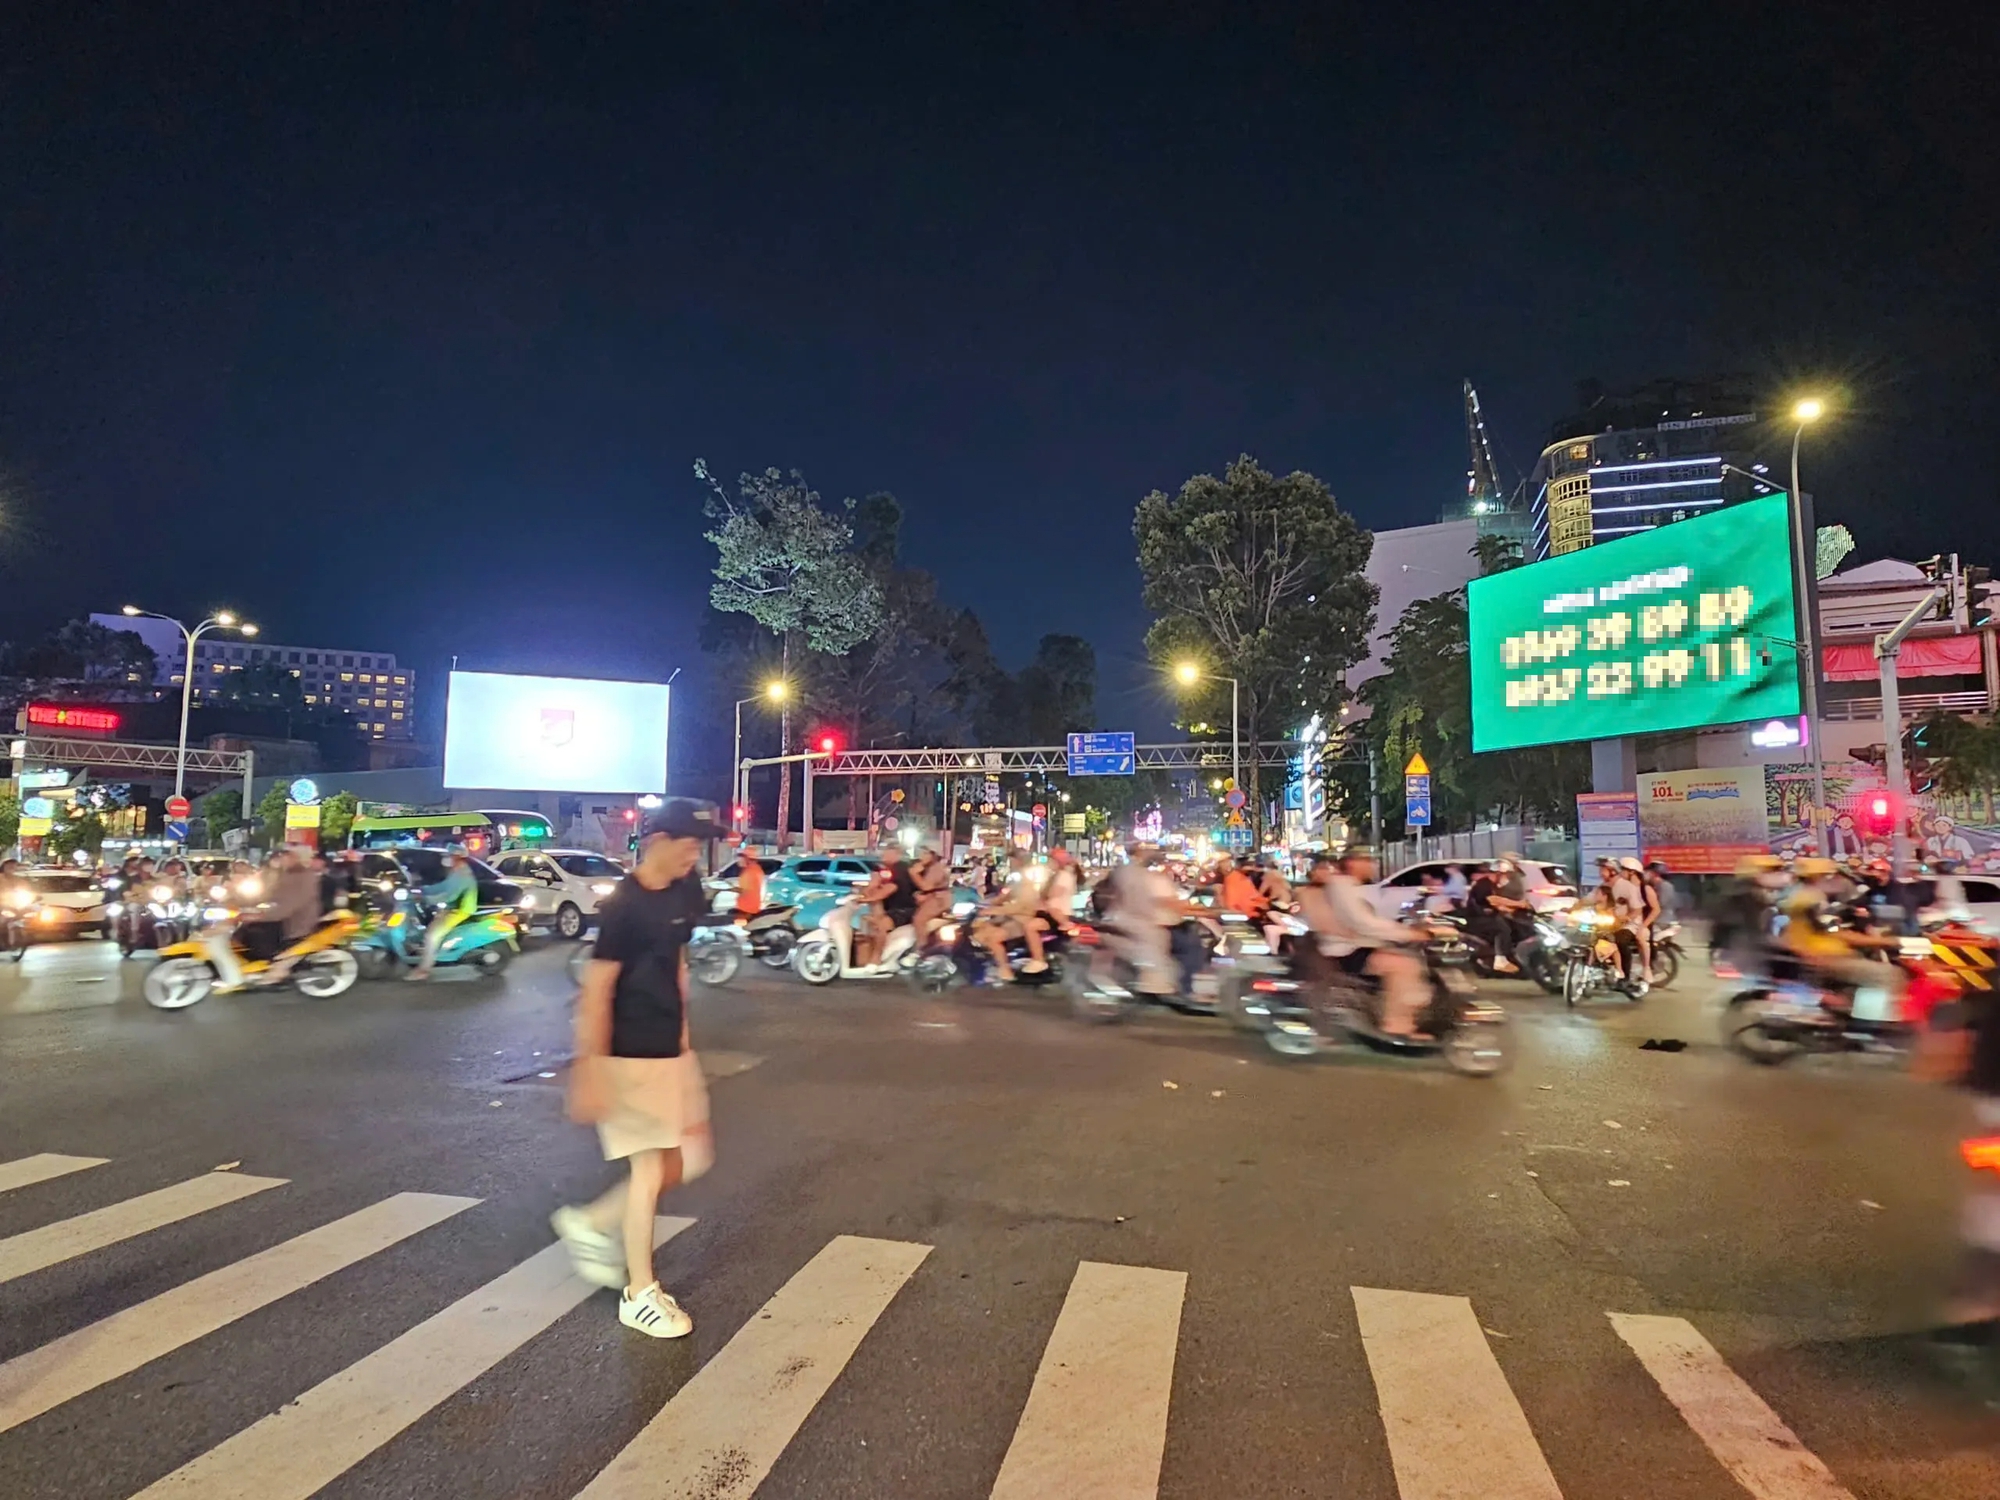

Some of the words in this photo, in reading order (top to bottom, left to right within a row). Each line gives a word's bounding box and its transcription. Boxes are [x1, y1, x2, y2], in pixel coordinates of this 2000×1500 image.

[29, 706, 58, 724] THE
[66, 710, 117, 729] STREET
[1652, 786, 1673, 798] 101
